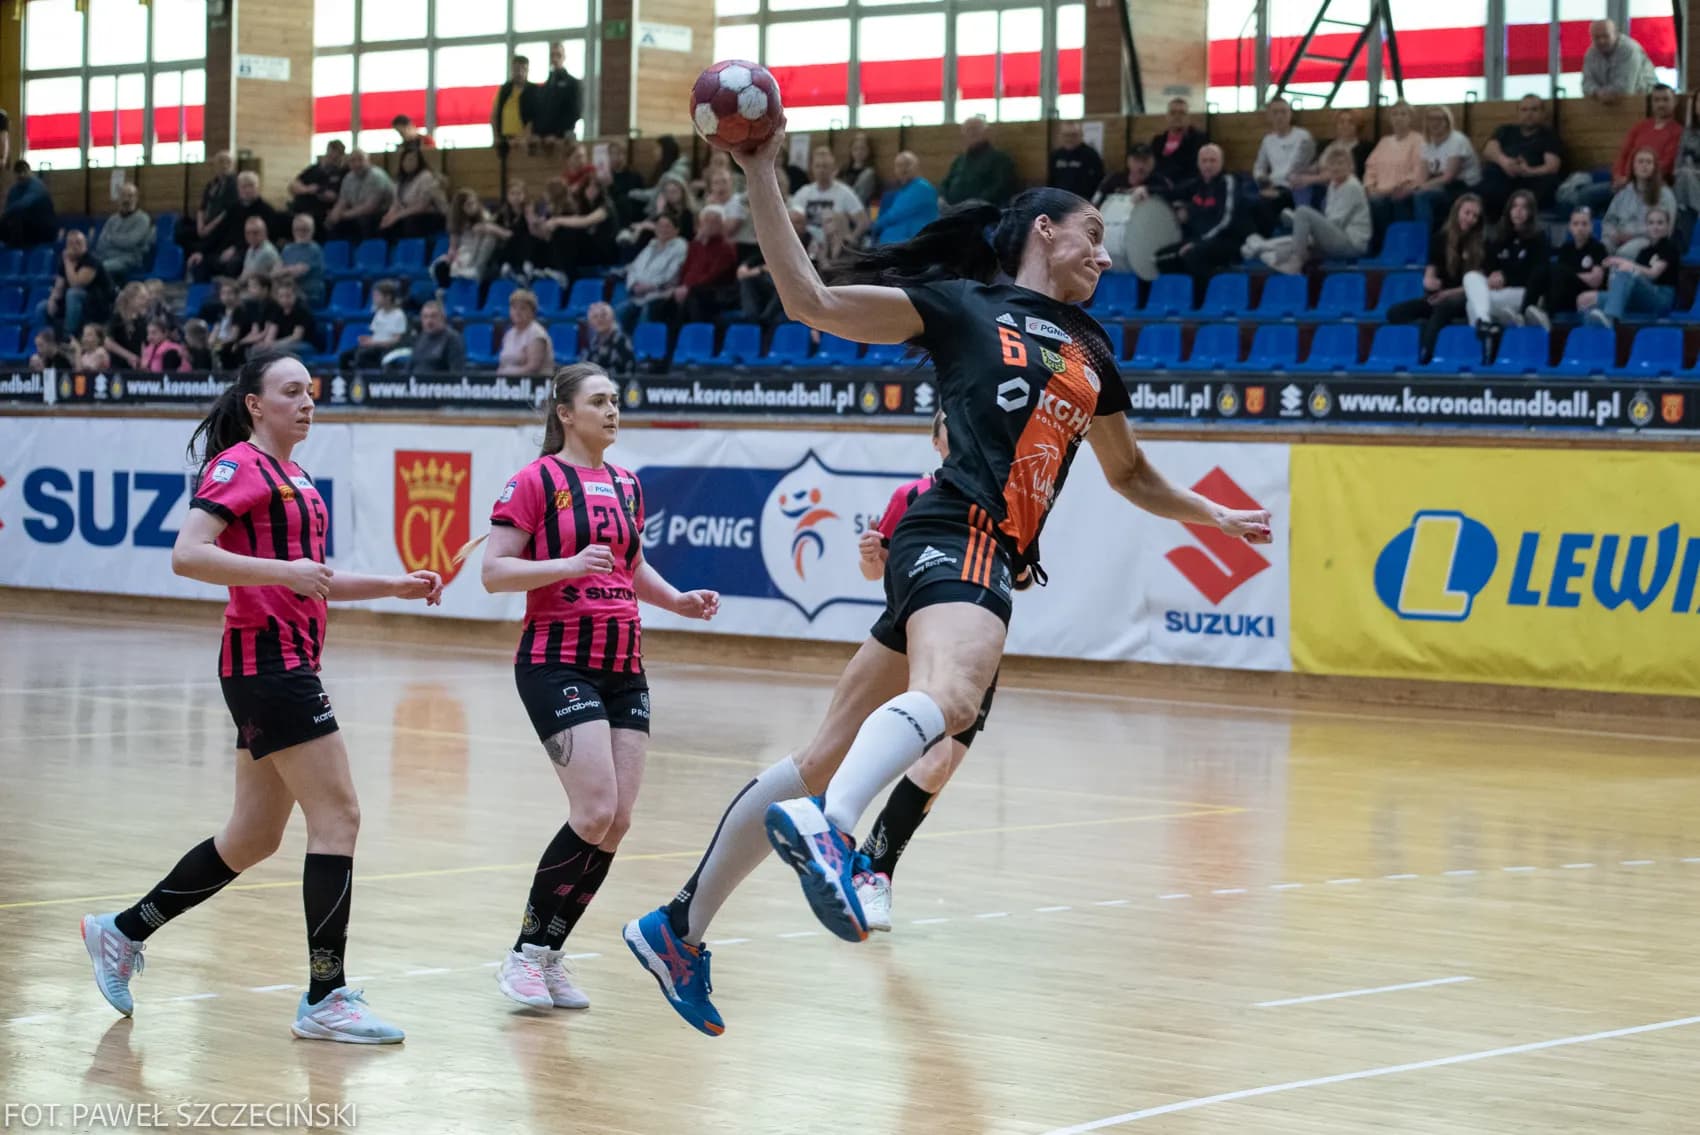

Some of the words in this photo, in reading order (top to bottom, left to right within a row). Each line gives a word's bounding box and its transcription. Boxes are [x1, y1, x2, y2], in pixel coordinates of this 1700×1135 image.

[998, 326, 1028, 368] 6
[646, 381, 855, 413] www.koronahandball.pl
[1338, 386, 1621, 426] www.koronahandball.pl
[310, 498, 325, 537] 5
[593, 506, 624, 545] 21
[667, 516, 755, 548] PGNiG
[402, 505, 455, 573] CK
[1507, 522, 1700, 614] LEWI
[1165, 610, 1275, 638] SUZUKI
